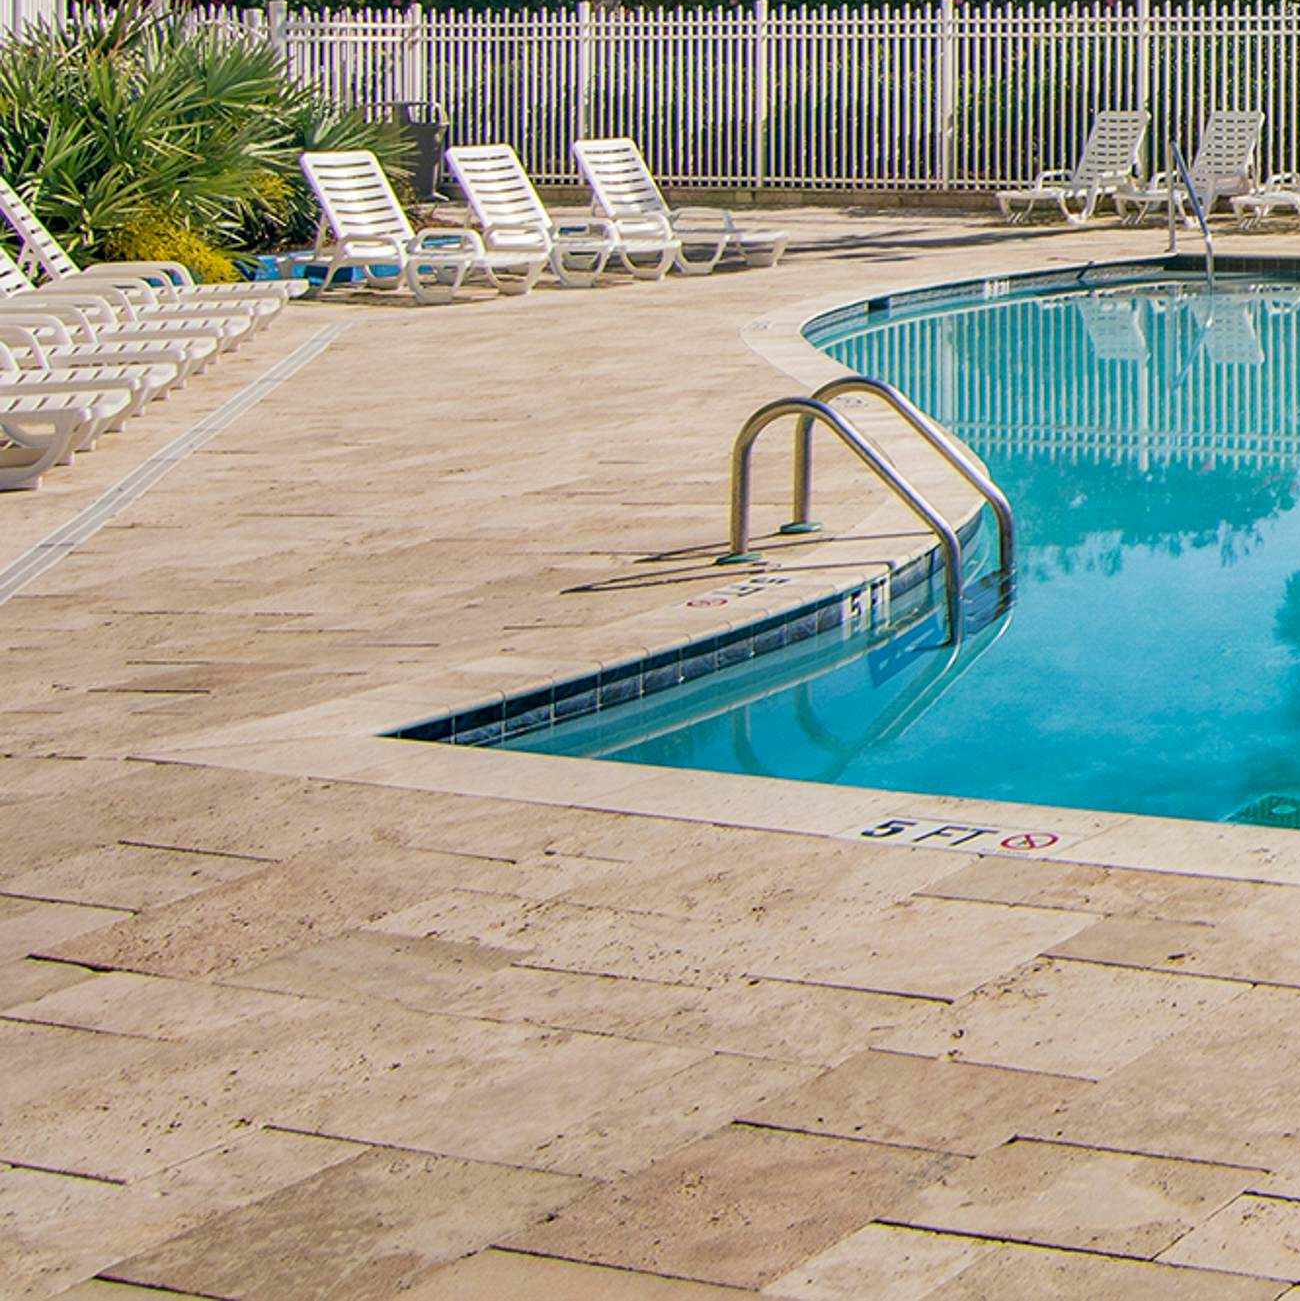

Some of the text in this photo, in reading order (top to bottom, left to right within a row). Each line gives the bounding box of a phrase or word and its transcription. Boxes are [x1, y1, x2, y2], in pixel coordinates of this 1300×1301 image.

[848, 589, 862, 620] 5
[861, 819, 1000, 846] 5 FT
